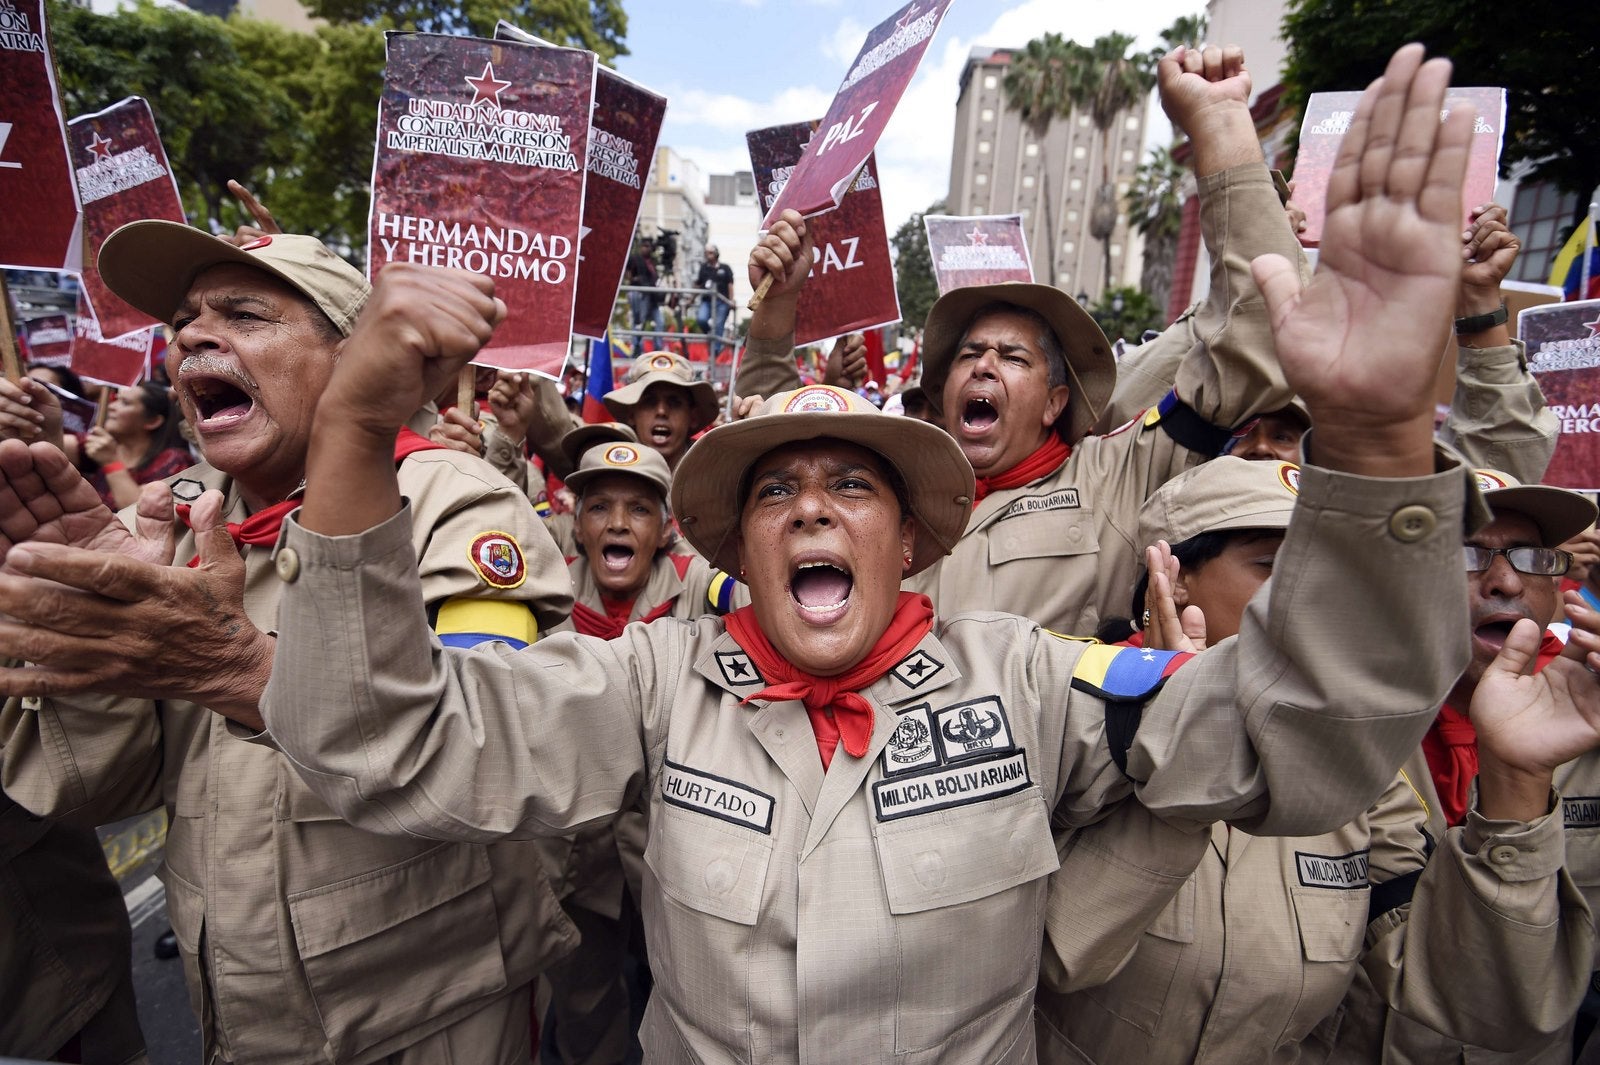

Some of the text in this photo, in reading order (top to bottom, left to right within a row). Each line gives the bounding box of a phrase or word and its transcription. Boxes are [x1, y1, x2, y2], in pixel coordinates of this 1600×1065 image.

[398, 116, 465, 139] CONTRA
[469, 124, 487, 142] LA
[409, 98, 562, 133] UNIDAD NACIONAL
[816, 101, 879, 156] PAZ
[387, 131, 578, 172] IMPERIALISTA A LA PATRIA
[591, 126, 634, 157] IONAL
[600, 161, 641, 189] PATRIA
[378, 213, 571, 259] HERMANDAD
[380, 238, 399, 262] Y
[408, 243, 567, 284] HEROISMO
[1027, 493, 1077, 510] BOLIVARIANA
[665, 775, 756, 817] HURTADO
[880, 761, 1024, 808] MILICIA BOLIVARIANA
[1563, 803, 1600, 822] ARIAN
[1304, 859, 1344, 883] MILICIA
